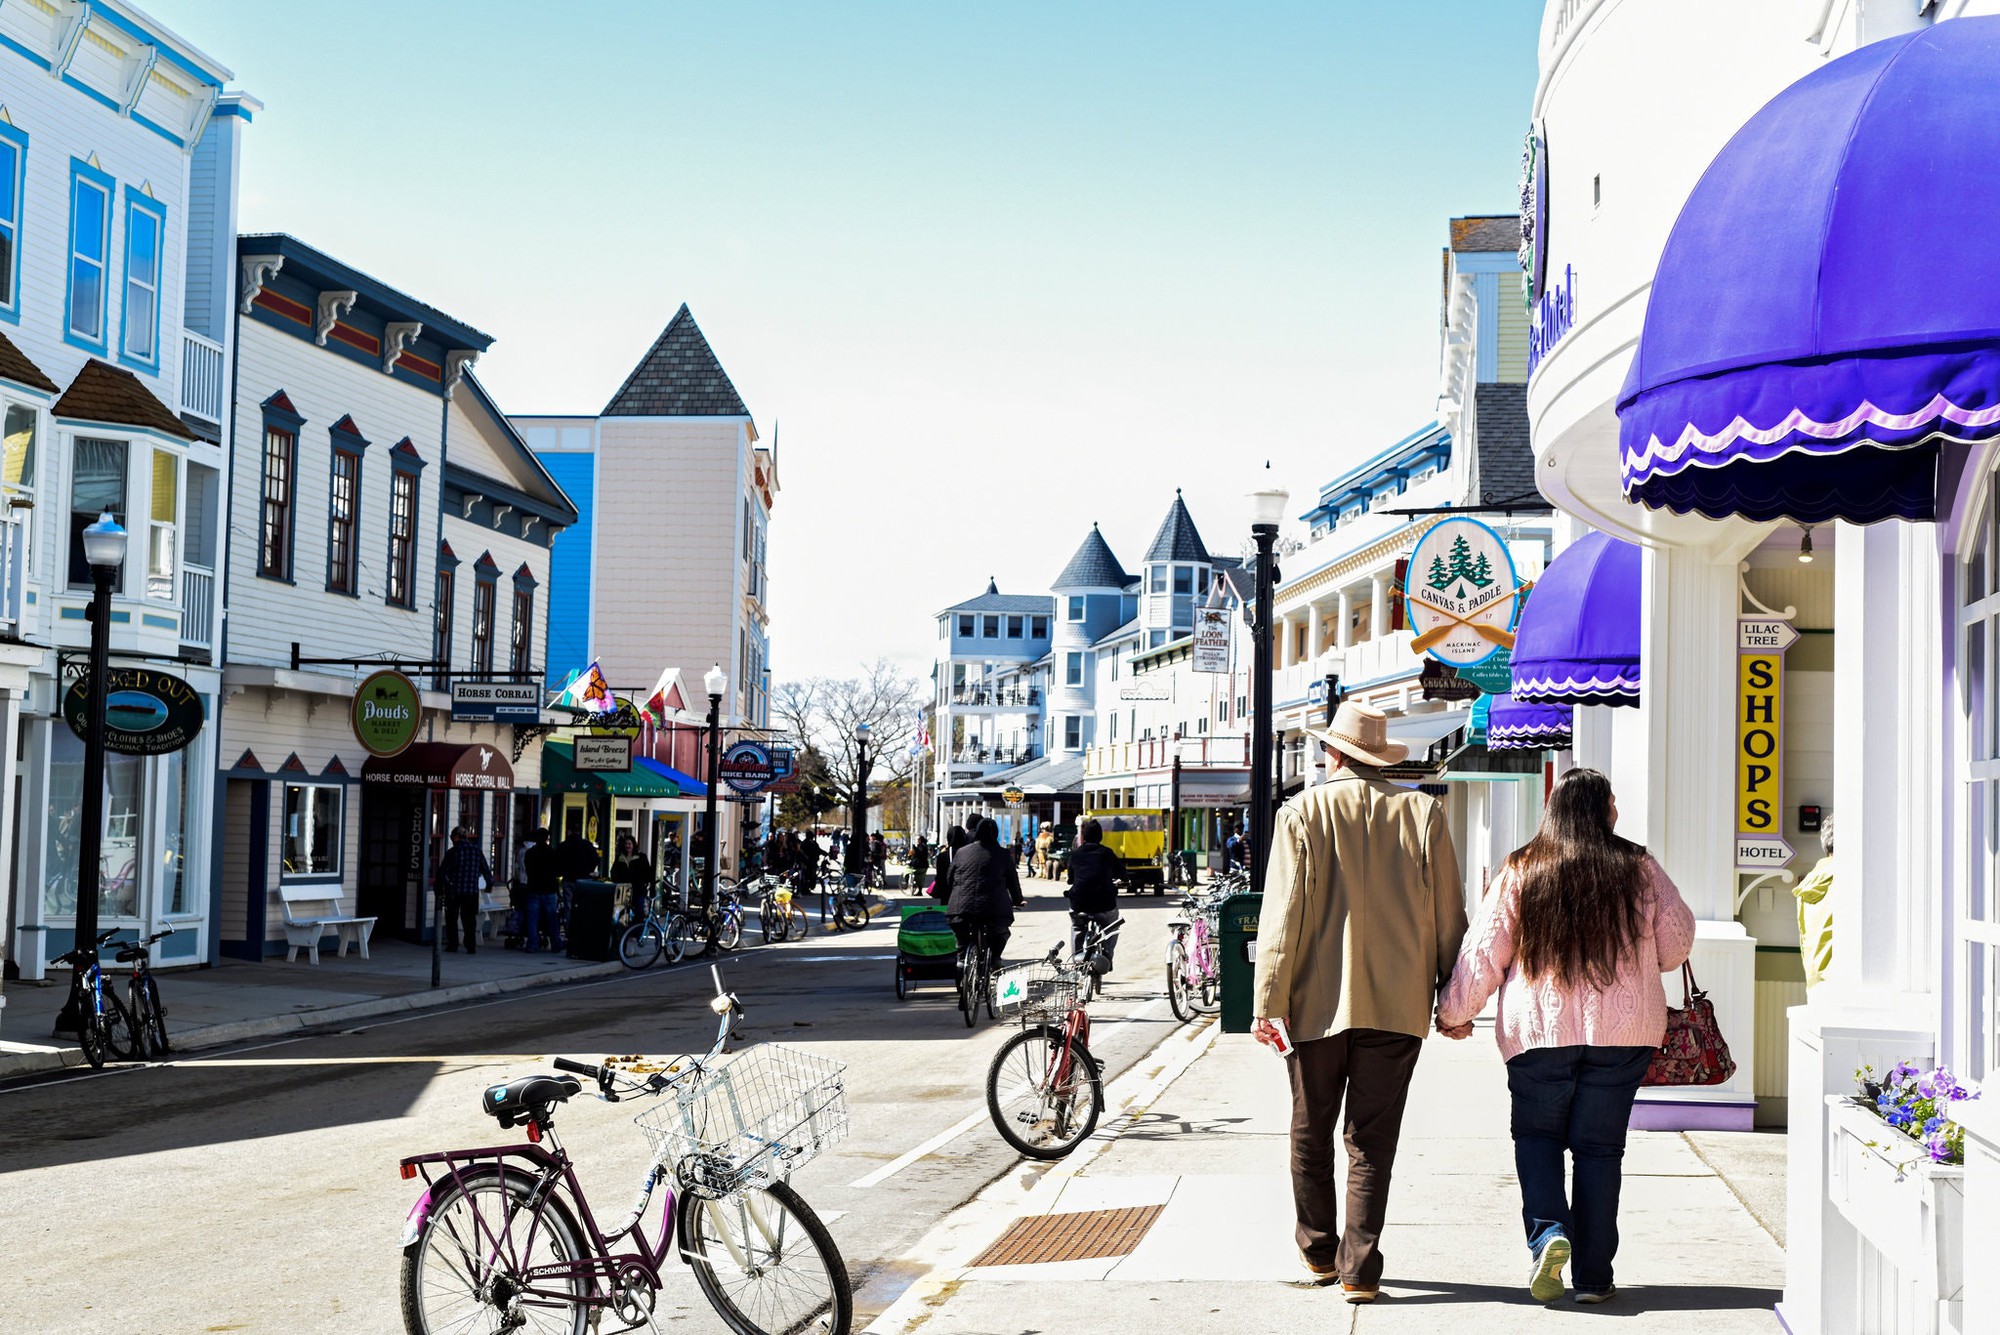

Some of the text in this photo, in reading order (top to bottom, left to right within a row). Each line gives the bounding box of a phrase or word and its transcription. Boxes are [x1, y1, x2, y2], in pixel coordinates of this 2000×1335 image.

[1540, 263, 1573, 358] Hotel
[1421, 585, 1502, 614] CANVAS & PADDLE
[1201, 630, 1224, 639] LOON
[1744, 625, 1780, 634] LILAC
[1195, 638, 1229, 647] FEATHER
[1746, 636, 1779, 645] TREE
[157, 676, 196, 705] OUT
[458, 687, 534, 699] HORSE CORRAL
[363, 700, 409, 721] Doud's
[108, 730, 144, 744] CLOTHES
[156, 726, 184, 744] SHOES
[146, 735, 186, 751] TRADITION
[580, 744, 627, 754] Island Breeze
[1743, 659, 1776, 829] SHOPS
[605, 757, 622, 765] Gallery
[365, 773, 447, 784] HORSE CORRAL MALL
[455, 773, 511, 789] HORSE CORRAL MALL
[411, 807, 423, 869] SHOPS
[1739, 847, 1787, 859] HOTEL
[1238, 915, 1258, 925] TRA
[532, 1265, 572, 1276] SCHWINN
